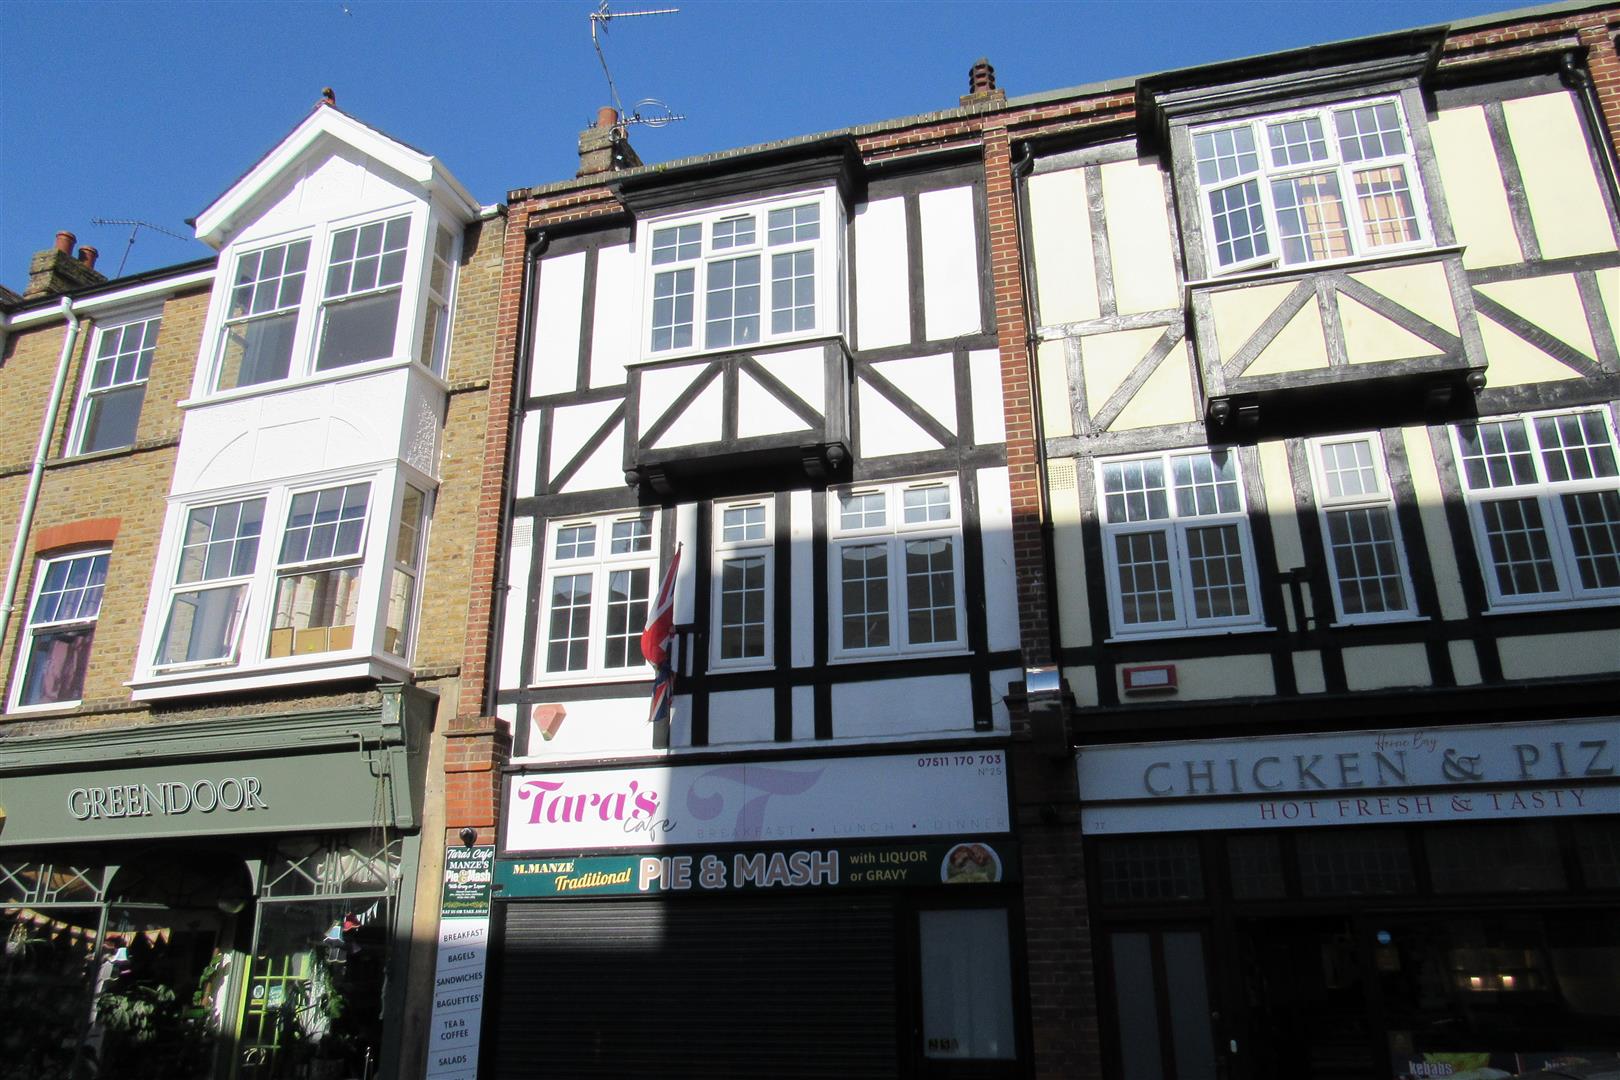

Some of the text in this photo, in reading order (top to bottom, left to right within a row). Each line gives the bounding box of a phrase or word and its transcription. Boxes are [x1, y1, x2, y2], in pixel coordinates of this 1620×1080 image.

[917, 754, 1001, 768] 07511 170 703
[1143, 751, 1412, 796] CHICKEN
[1441, 748, 1484, 781] &
[67, 776, 269, 821] GREENDOOR
[518, 780, 658, 824] Tara's
[1259, 789, 1586, 820] HOT FRESH & TASTY
[697, 817, 1008, 840] BREAKFAST LUNCH DINNER
[449, 860, 489, 869] MANZE'S
[849, 850, 928, 865] with LIQUOR
[446, 870, 459, 882] Pie
[468, 870, 491, 882] Mash
[638, 849, 840, 891] PIE & MASH
[850, 868, 908, 882] or GRAVY
[555, 868, 632, 891] Traditional
[443, 929, 484, 942] BREAKFAST
[447, 951, 475, 963] BAGELS
[436, 971, 483, 986] SANDWICHES
[444, 1020, 458, 1029] TEA
[440, 1029, 469, 1040] COFFEE
[438, 1054, 467, 1066] SALADS
[1408, 1060, 1453, 1076] kebabs
